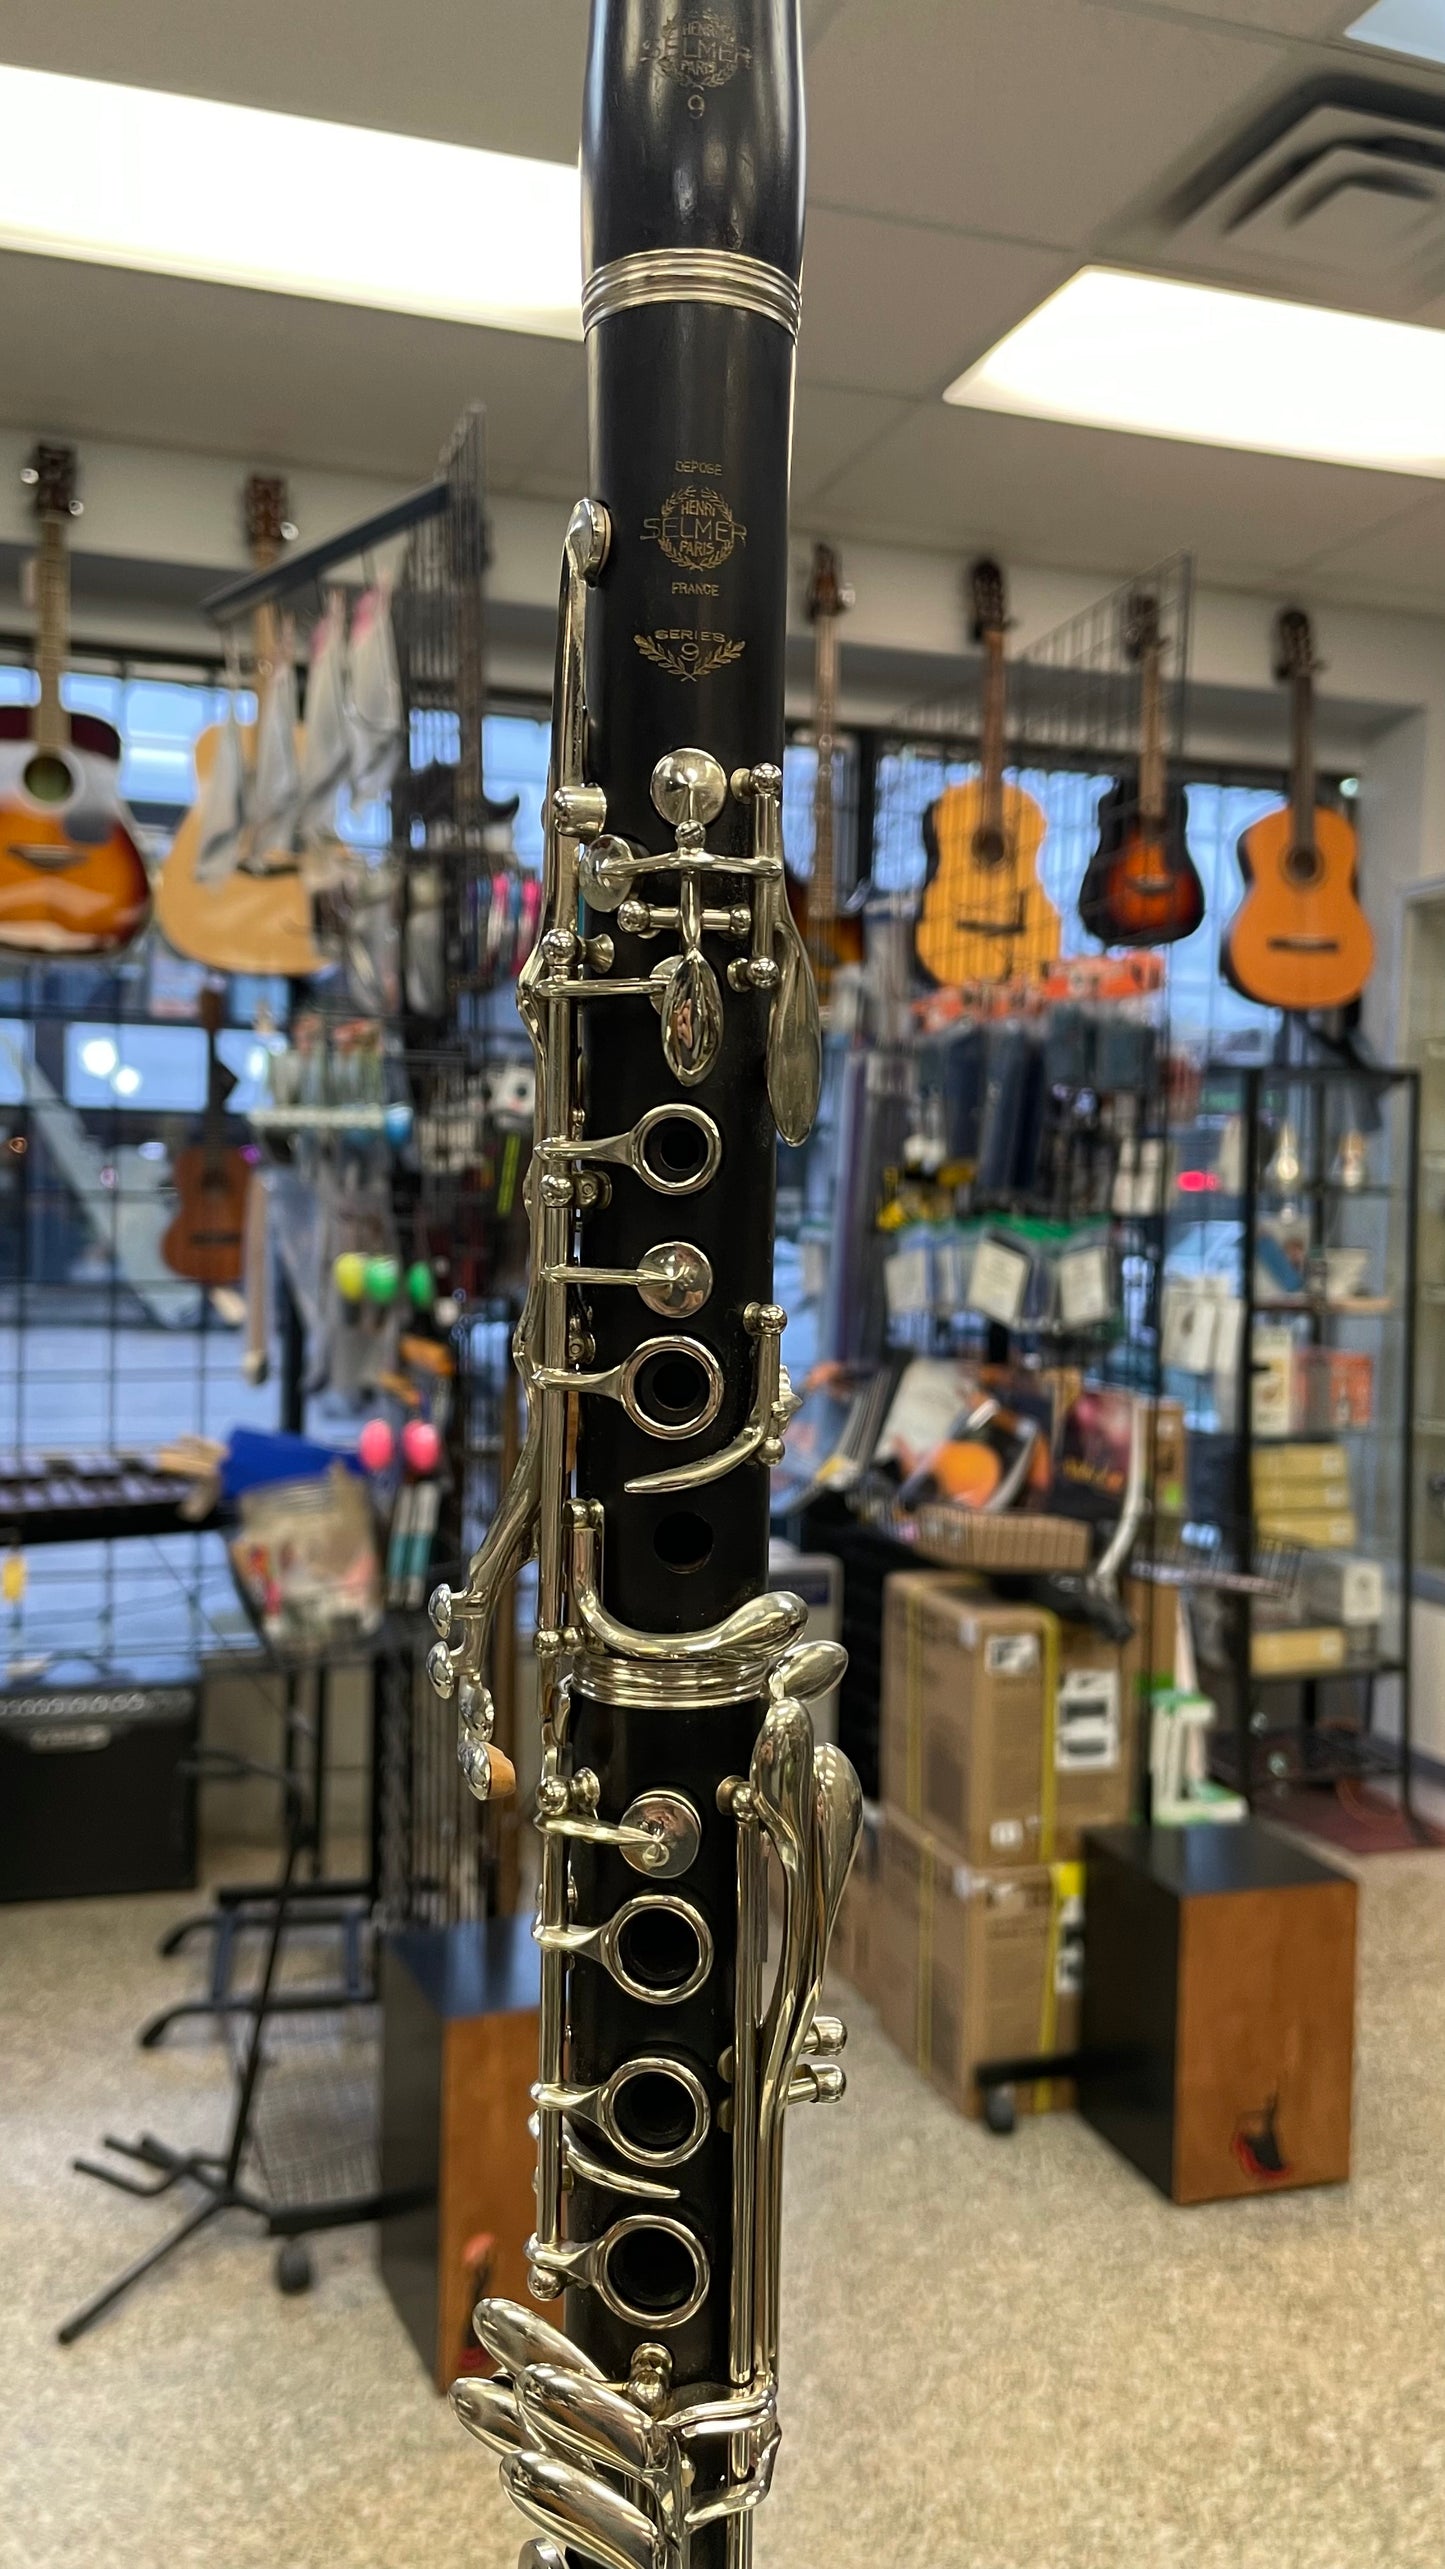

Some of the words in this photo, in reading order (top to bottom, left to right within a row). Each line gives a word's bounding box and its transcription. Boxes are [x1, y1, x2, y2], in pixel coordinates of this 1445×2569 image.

[680, 60, 716, 75] PARIS
[687, 94, 705, 120] 9
[681, 500, 715, 517] HENRI
[640, 517, 748, 547] SELMER
[680, 540, 715, 557] PARIS
[671, 582, 720, 597] FRANCE
[654, 629, 726, 643] SERIES
[680, 642, 700, 662] 9
